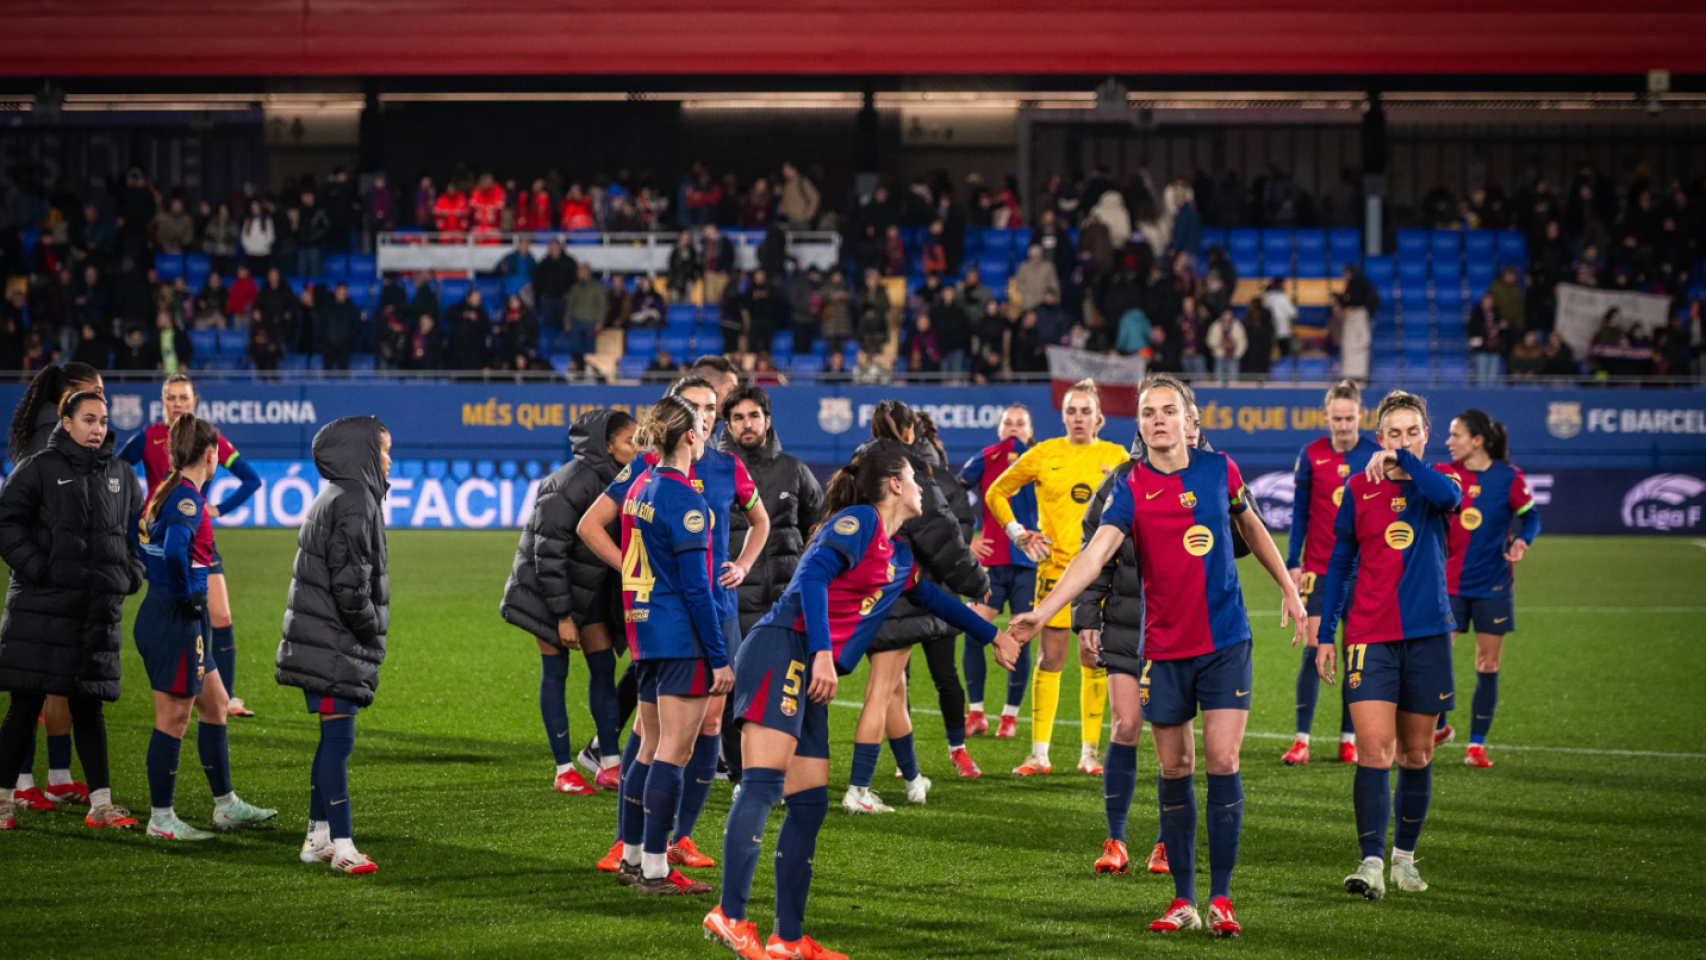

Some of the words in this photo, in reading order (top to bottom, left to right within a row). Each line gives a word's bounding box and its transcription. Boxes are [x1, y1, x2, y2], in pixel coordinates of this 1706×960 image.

[196, 401, 317, 424] ARCELONA
[462, 398, 512, 426] MÉS
[517, 403, 565, 430] QUE
[1200, 400, 1233, 430] ÉS
[1238, 405, 1287, 434] QUE
[1587, 408, 1617, 433] FC
[208, 463, 326, 528] CIÓ
[1636, 503, 1685, 530] Liga
[1687, 506, 1702, 527] F
[622, 528, 655, 603] 4
[196, 635, 205, 663] 9
[1347, 643, 1367, 671] 11
[783, 659, 806, 696] 5
